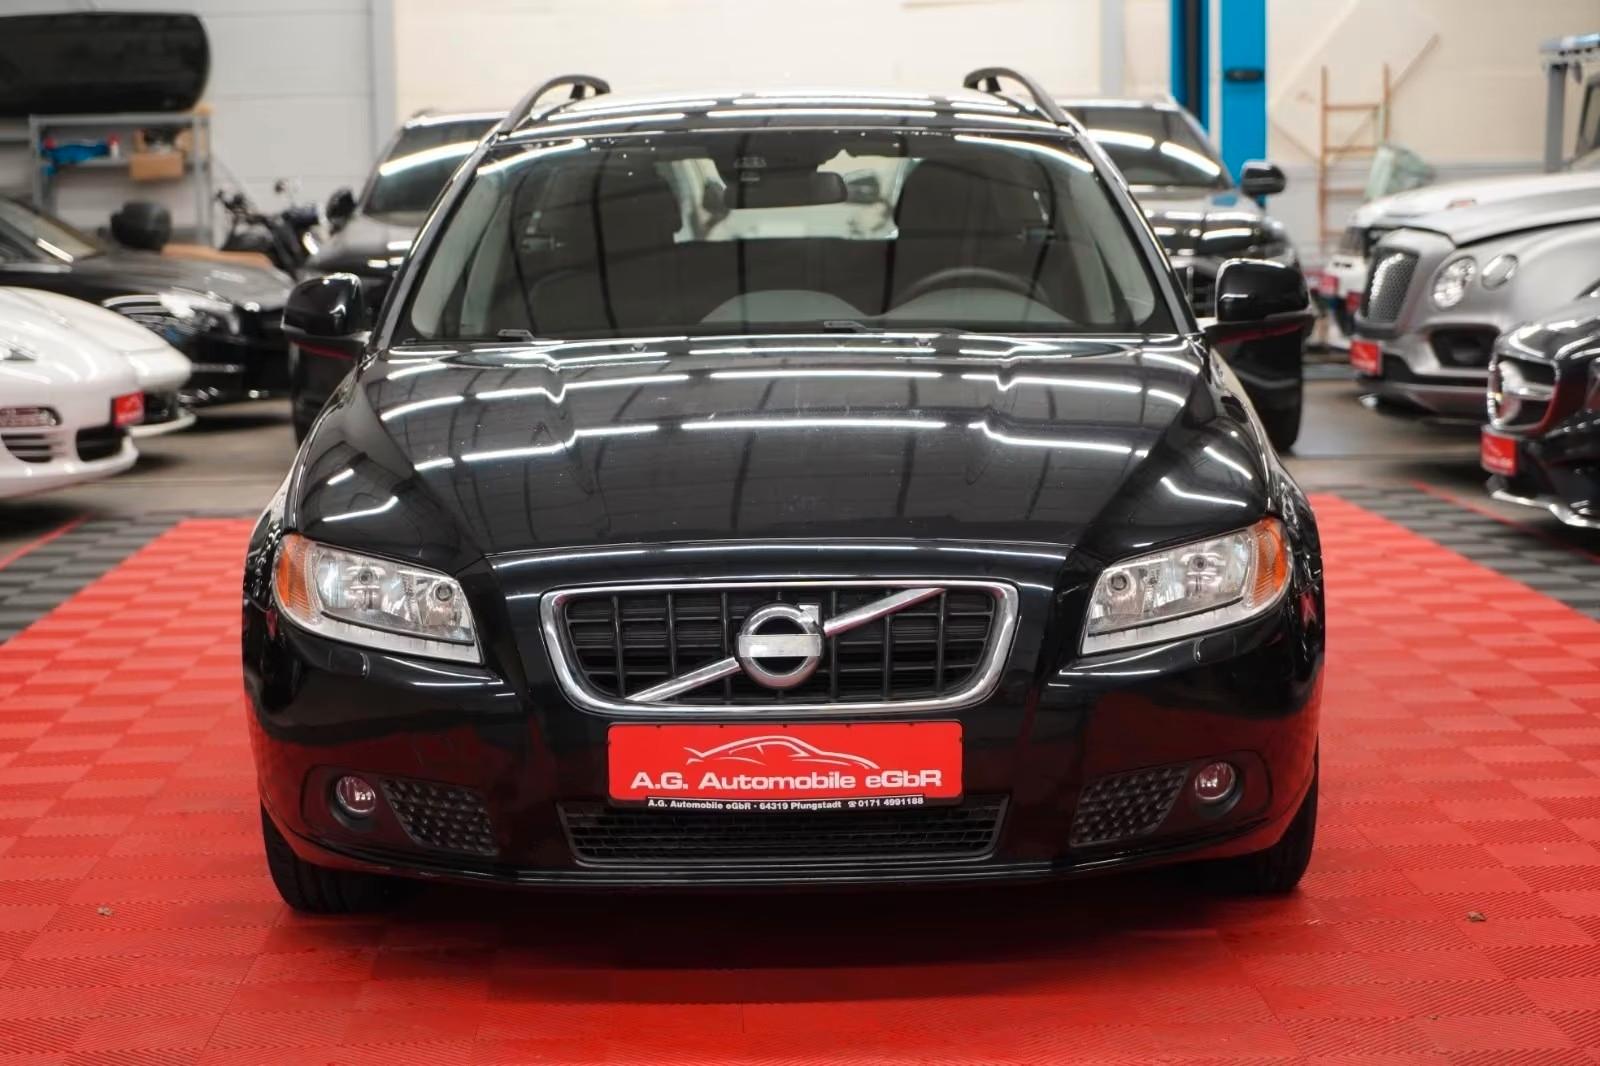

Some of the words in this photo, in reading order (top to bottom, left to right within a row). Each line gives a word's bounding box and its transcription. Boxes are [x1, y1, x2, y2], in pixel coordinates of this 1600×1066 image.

[630, 771, 689, 790] A.G.
[697, 771, 857, 790] Automobile
[865, 769, 942, 789] eGbR
[647, 799, 668, 808] A.G.
[669, 800, 724, 810] Automobile
[725, 801, 752, 810] eGbR
[759, 802, 789, 810] 64319
[790, 800, 842, 811] Pfungstadt
[857, 799, 881, 808] 0171
